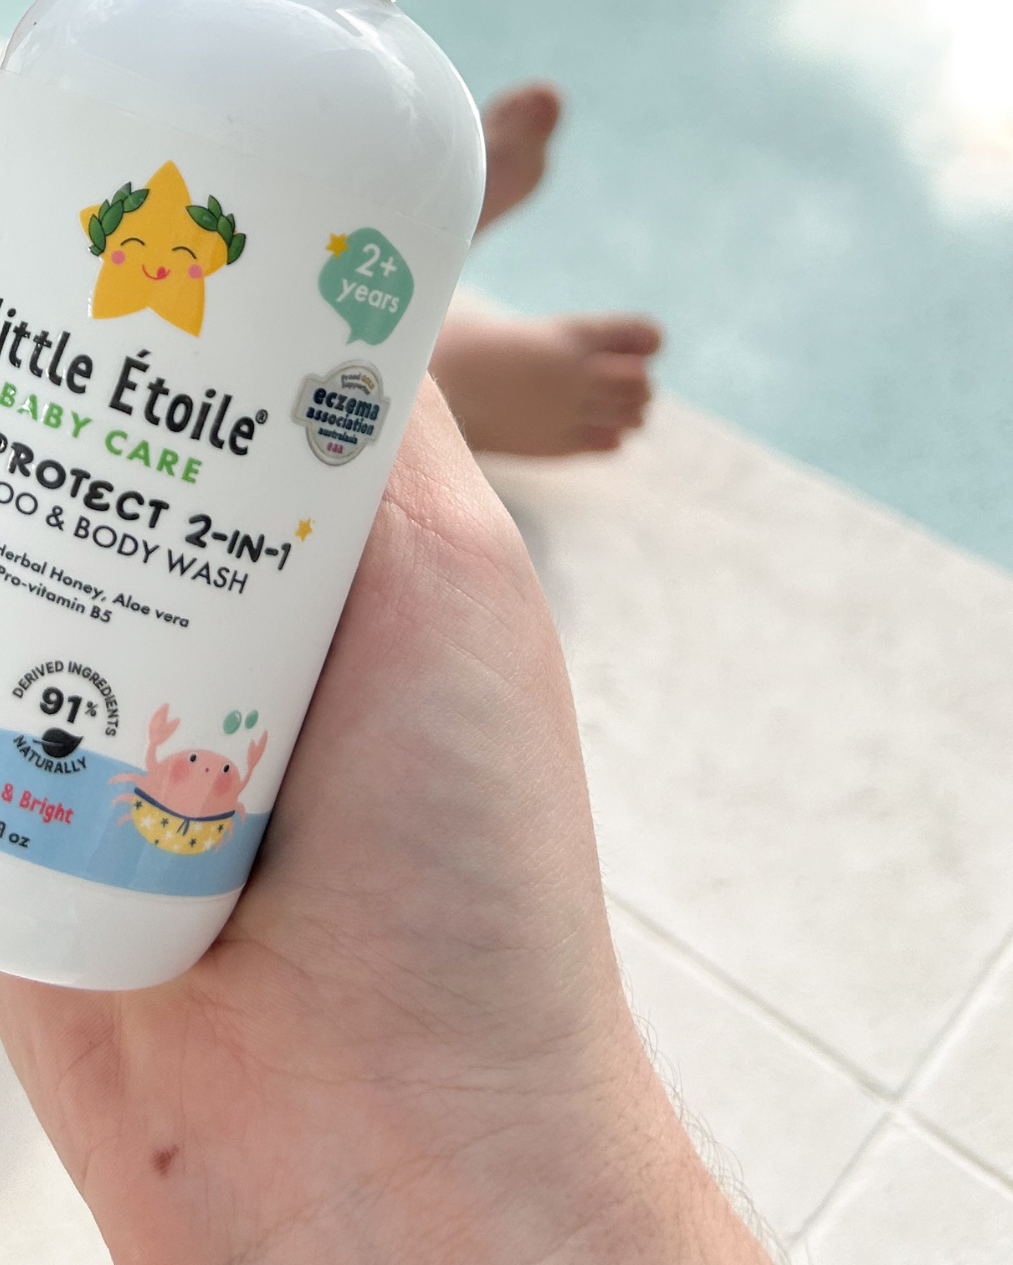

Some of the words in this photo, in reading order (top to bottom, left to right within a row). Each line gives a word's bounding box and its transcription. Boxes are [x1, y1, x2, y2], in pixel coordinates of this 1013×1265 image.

[354, 243, 397, 277] 2+
[335, 278, 400, 313] years
[305, 406, 375, 436] association
[313, 387, 380, 421] eczema
[104, 429, 203, 485] CARE
[45, 505, 66, 531] &
[74, 516, 160, 564] BODY
[167, 548, 248, 594] WASH
[184, 514, 292, 571] 2-IN-1
[50, 565, 107, 602] Honey,
[112, 592, 150, 616] Aloe
[154, 609, 190, 628] vera
[89, 605, 113, 624] B5
[12, 660, 64, 699] DERIVED
[67, 660, 120, 737] INGREDIENTS
[12, 735, 88, 775] NATURALLY
[1, 782, 14, 803] &
[19, 789, 74, 825] Bright
[8, 832, 31, 848] oz
